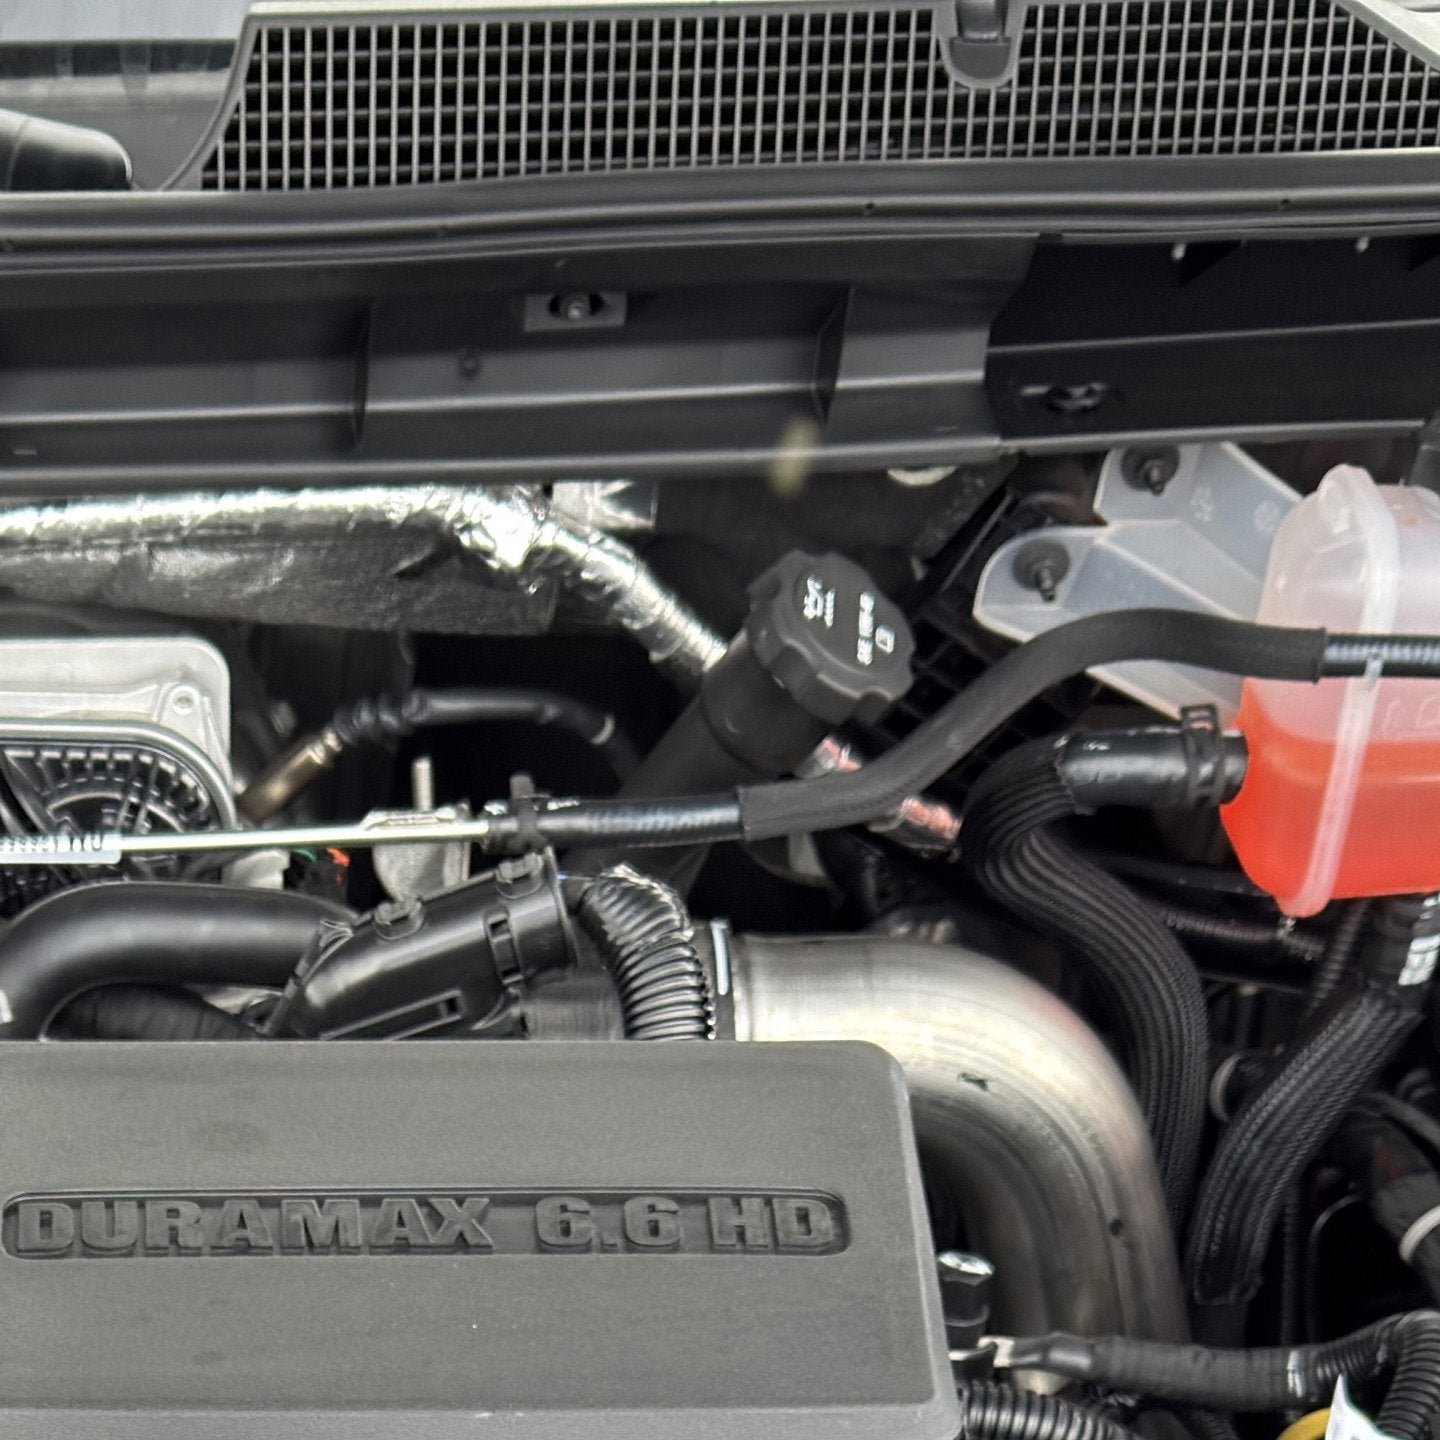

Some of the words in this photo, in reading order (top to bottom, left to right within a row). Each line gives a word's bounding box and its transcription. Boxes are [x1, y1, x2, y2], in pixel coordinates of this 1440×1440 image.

[16, 1195, 495, 1254] DURAMAX
[533, 1195, 684, 1252] 6.6
[707, 1195, 834, 1252] HD
